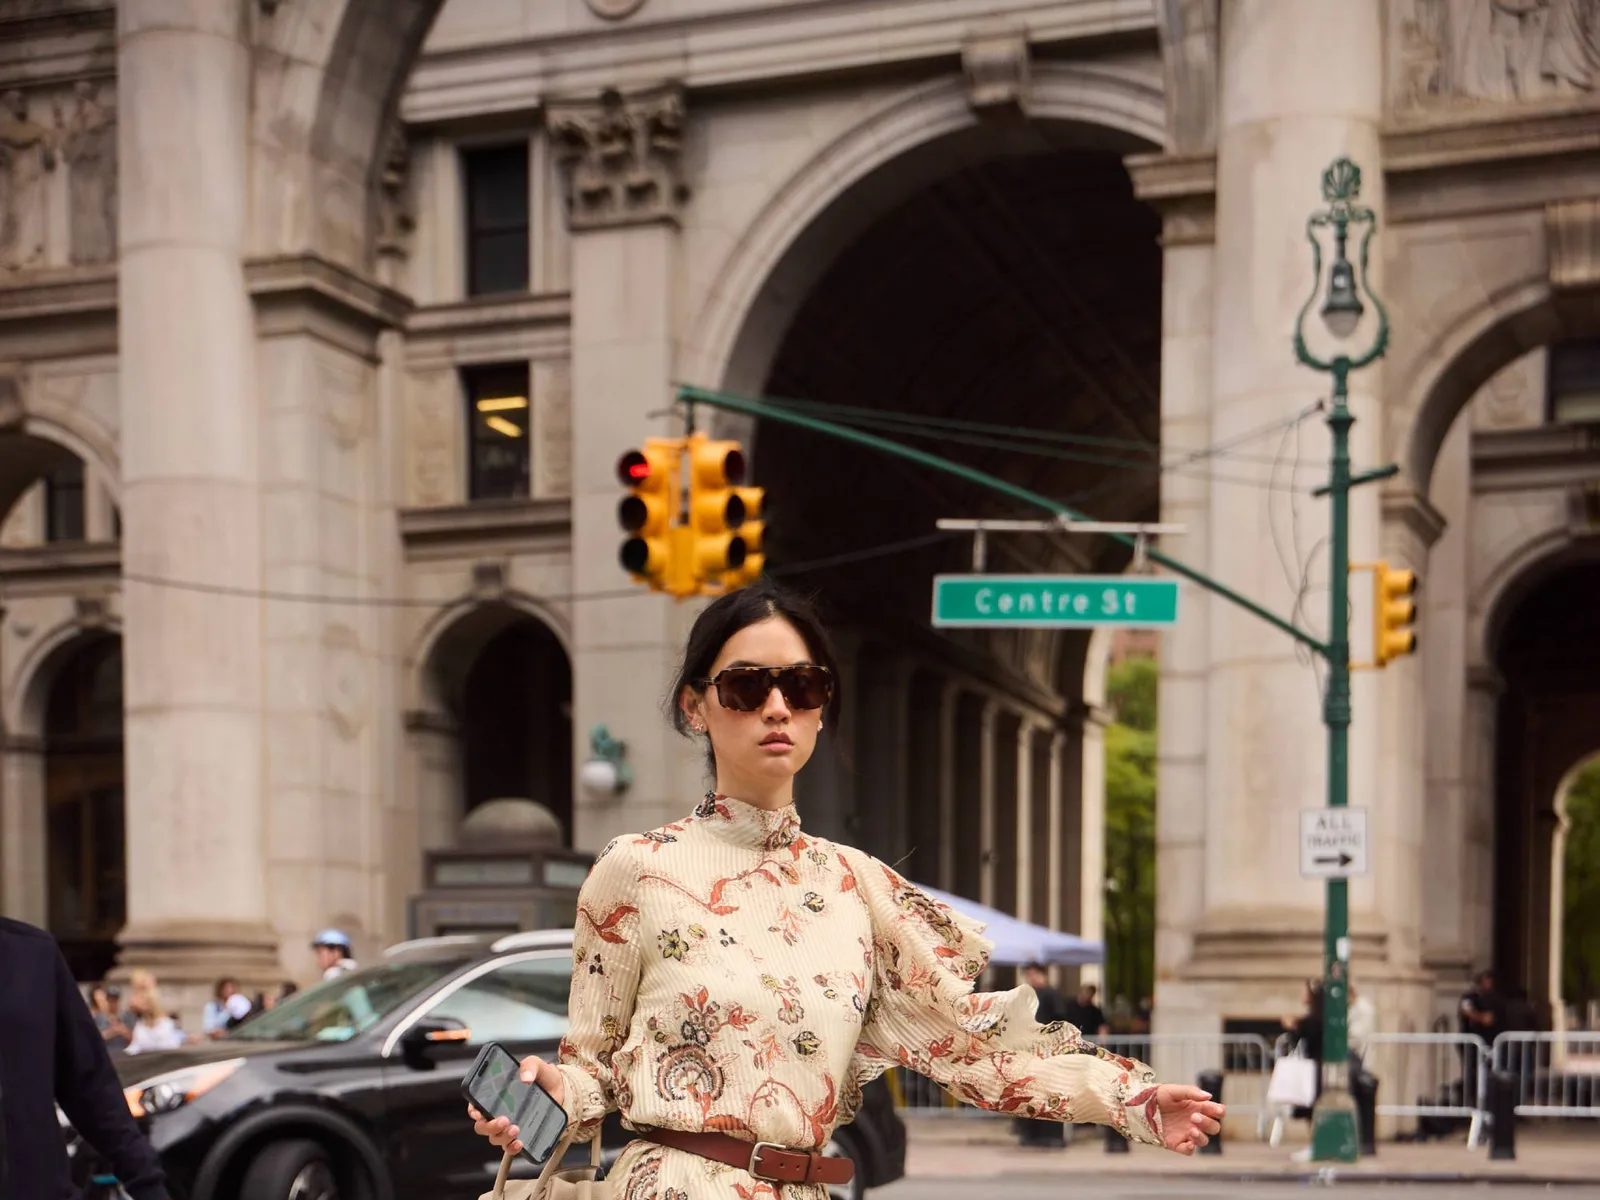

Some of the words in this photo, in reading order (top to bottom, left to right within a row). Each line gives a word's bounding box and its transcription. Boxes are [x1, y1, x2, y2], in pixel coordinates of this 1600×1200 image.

[974, 587, 1090, 614] Centre
[1101, 588, 1137, 615] St
[1315, 813, 1352, 830] ALL
